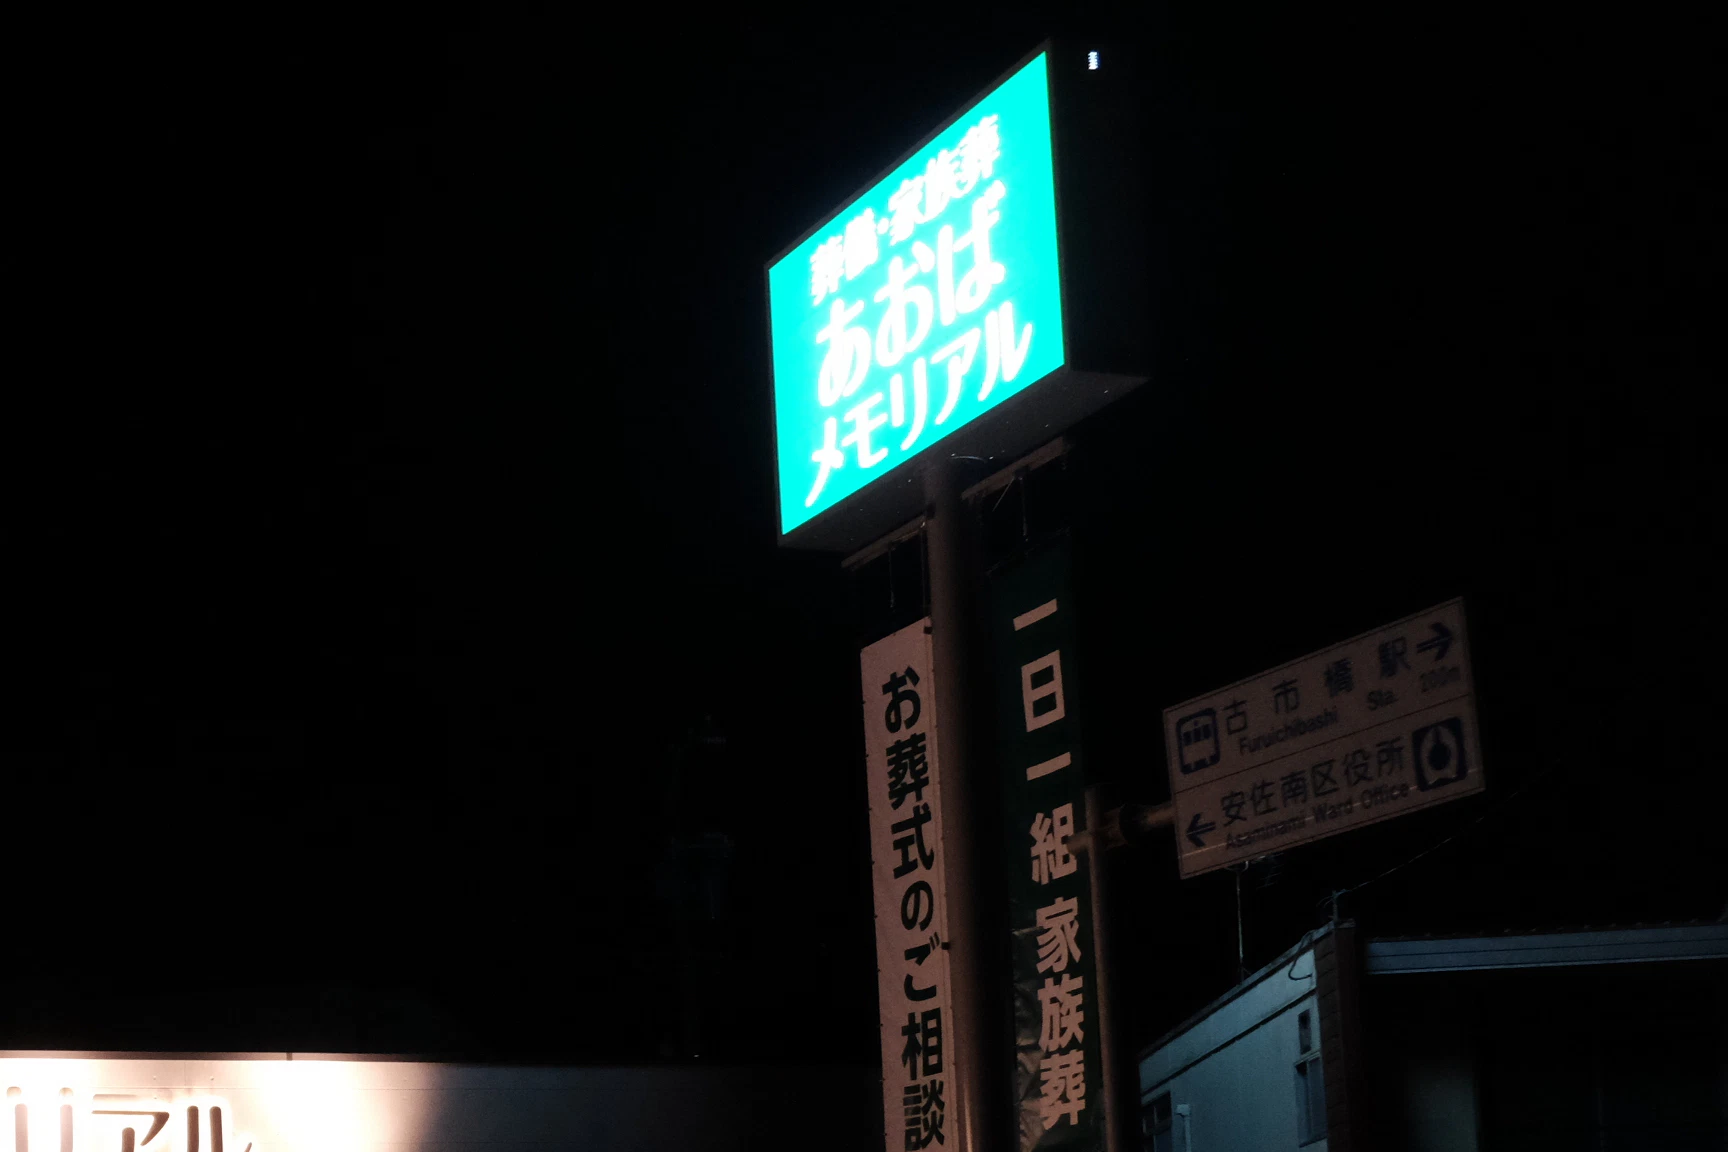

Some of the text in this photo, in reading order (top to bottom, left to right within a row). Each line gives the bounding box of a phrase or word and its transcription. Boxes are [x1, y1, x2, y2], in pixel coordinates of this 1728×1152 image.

[815, 180, 1006, 406] あおば
[805, 301, 1034, 507] メモリアル
[1222, 736, 1404, 827] 安佐南区役所
[1223, 636, 1412, 735] 古市橋駅
[1013, 597, 1086, 1131] 一日一組家族葬
[1313, 799, 1353, 823] Ward
[1360, 782, 1410, 810] Office
[882, 666, 945, 1152] お葬式のご相談
